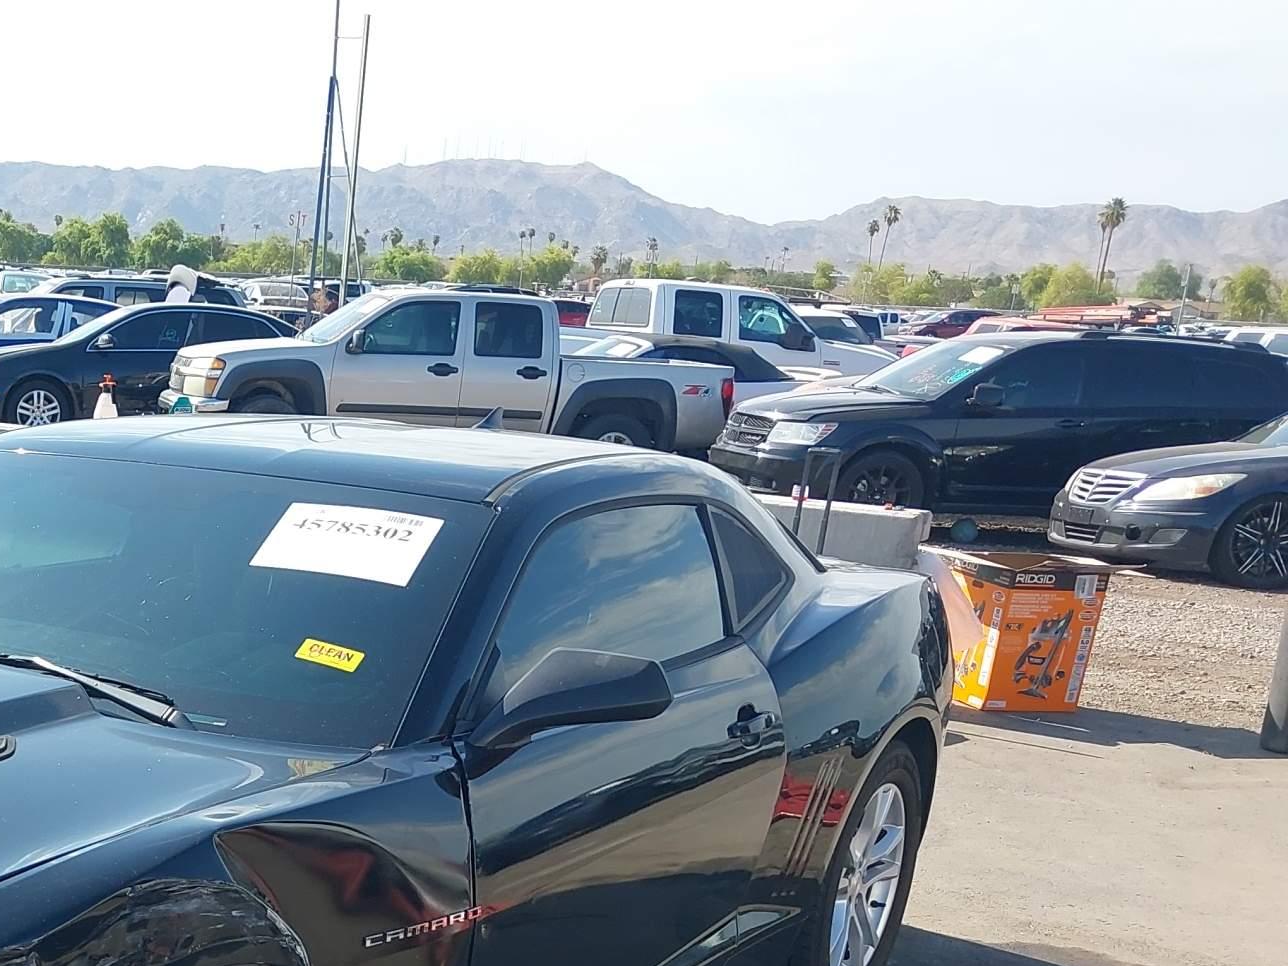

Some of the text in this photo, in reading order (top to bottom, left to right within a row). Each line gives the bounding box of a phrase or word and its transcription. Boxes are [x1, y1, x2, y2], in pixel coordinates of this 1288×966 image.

[293, 518, 413, 542] 45785302
[1015, 573, 1056, 584] RIDGID
[309, 643, 355, 663] CLEAN
